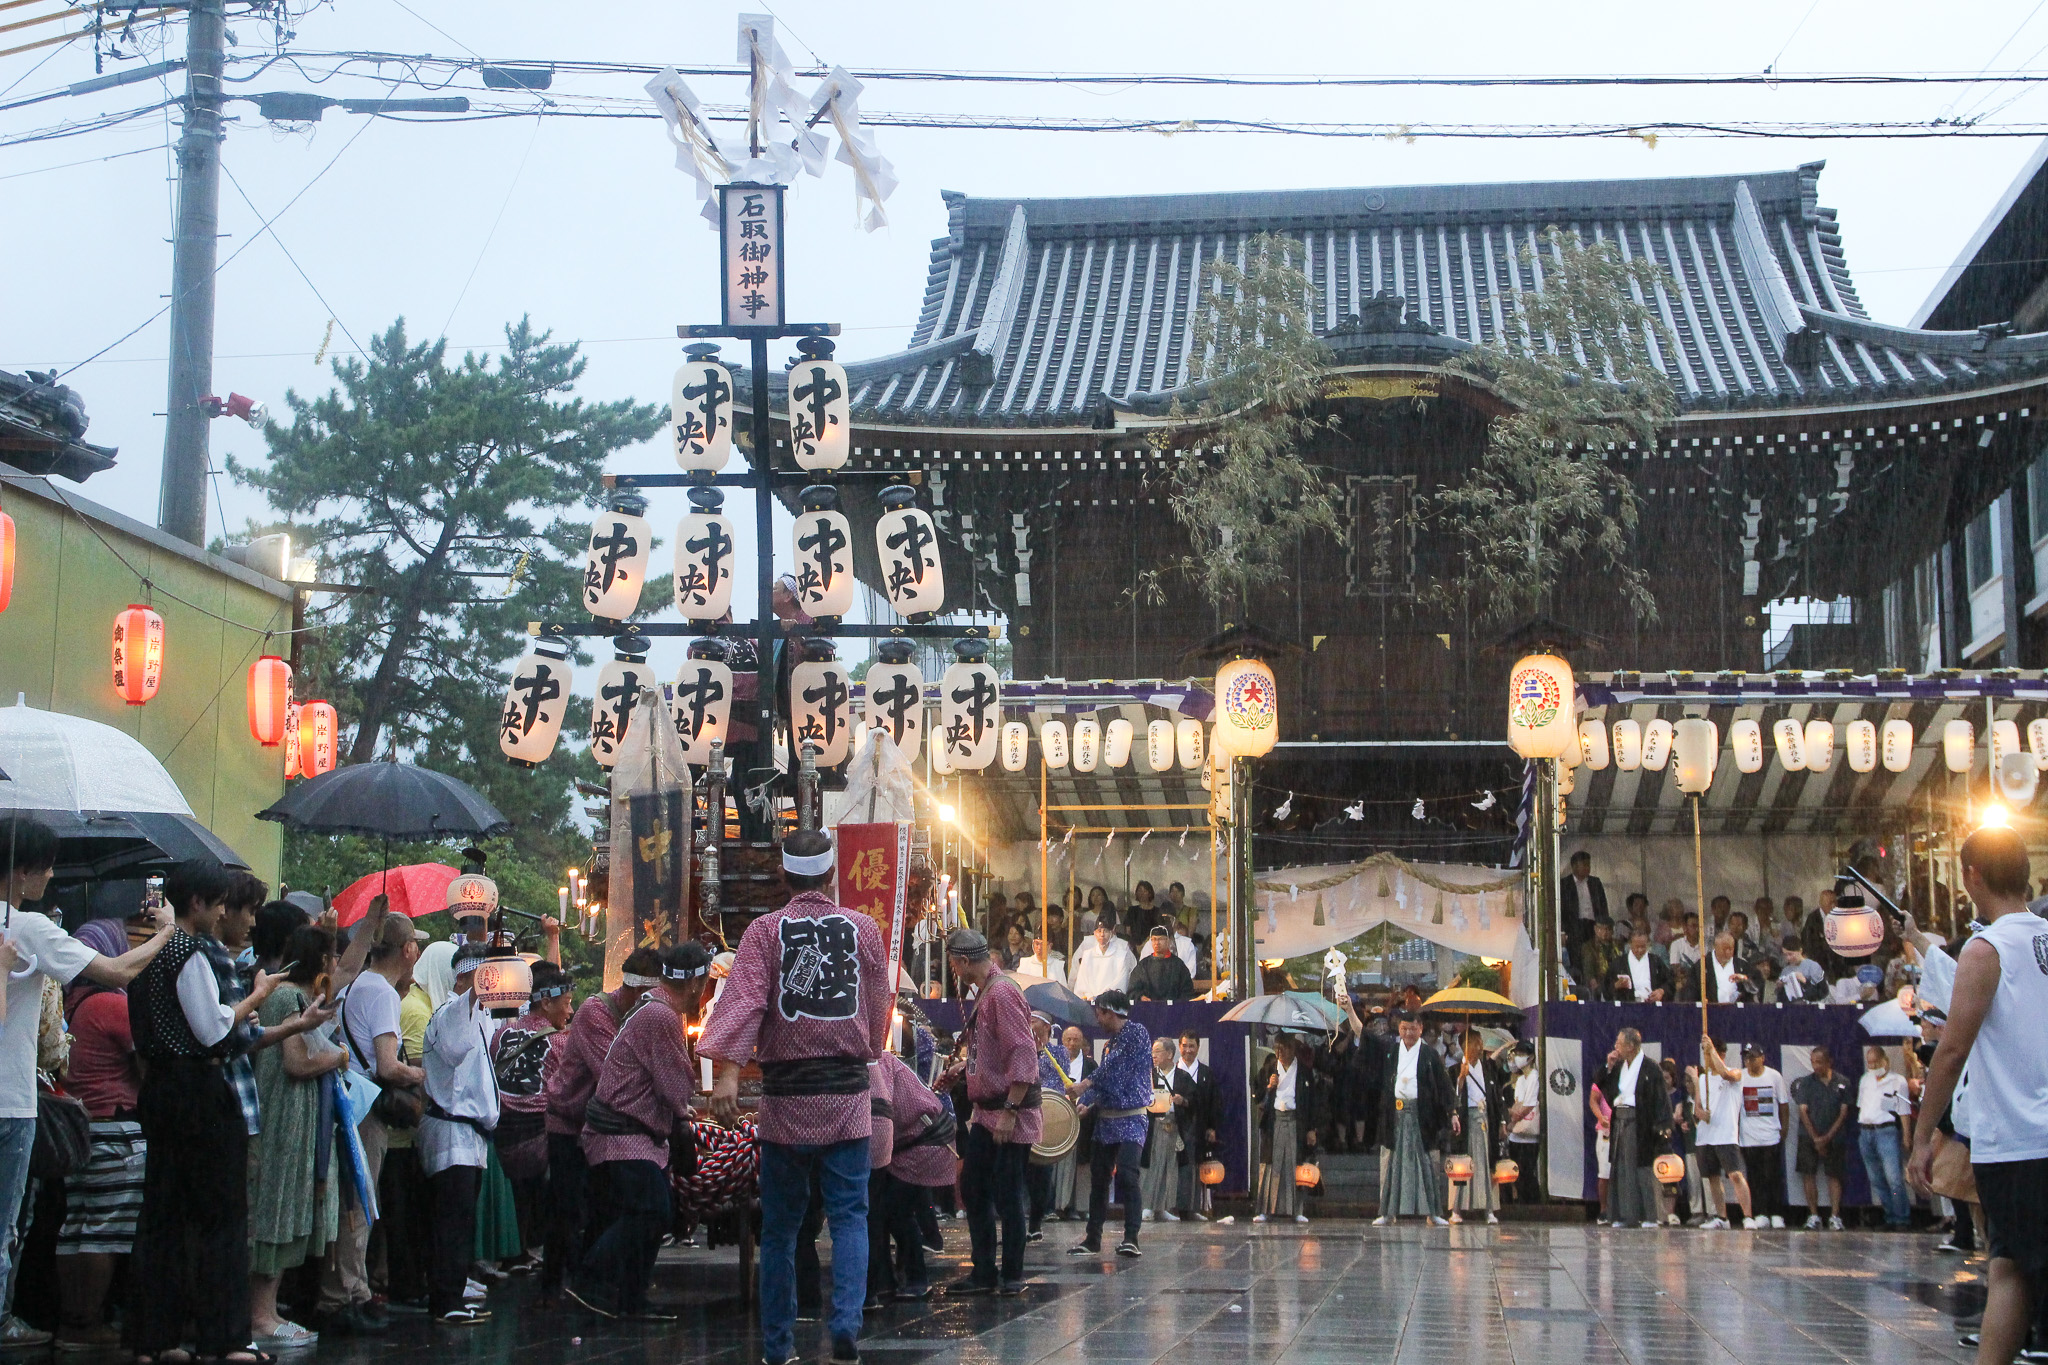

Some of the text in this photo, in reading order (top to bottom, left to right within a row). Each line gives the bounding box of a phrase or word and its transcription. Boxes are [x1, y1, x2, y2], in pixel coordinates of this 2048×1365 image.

[737, 193, 771, 319] 石取御神事
[676, 368, 731, 455] 中央
[792, 367, 842, 456] 中央
[679, 521, 733, 606] 中央
[797, 517, 847, 603] 中央
[885, 514, 934, 602] 中央
[946, 671, 997, 757] 中央
[1244, 681, 1263, 703] 大
[1010, 727, 1019, 765] 石取祭保存会
[1082, 726, 1091, 765] 石取祭保存会
